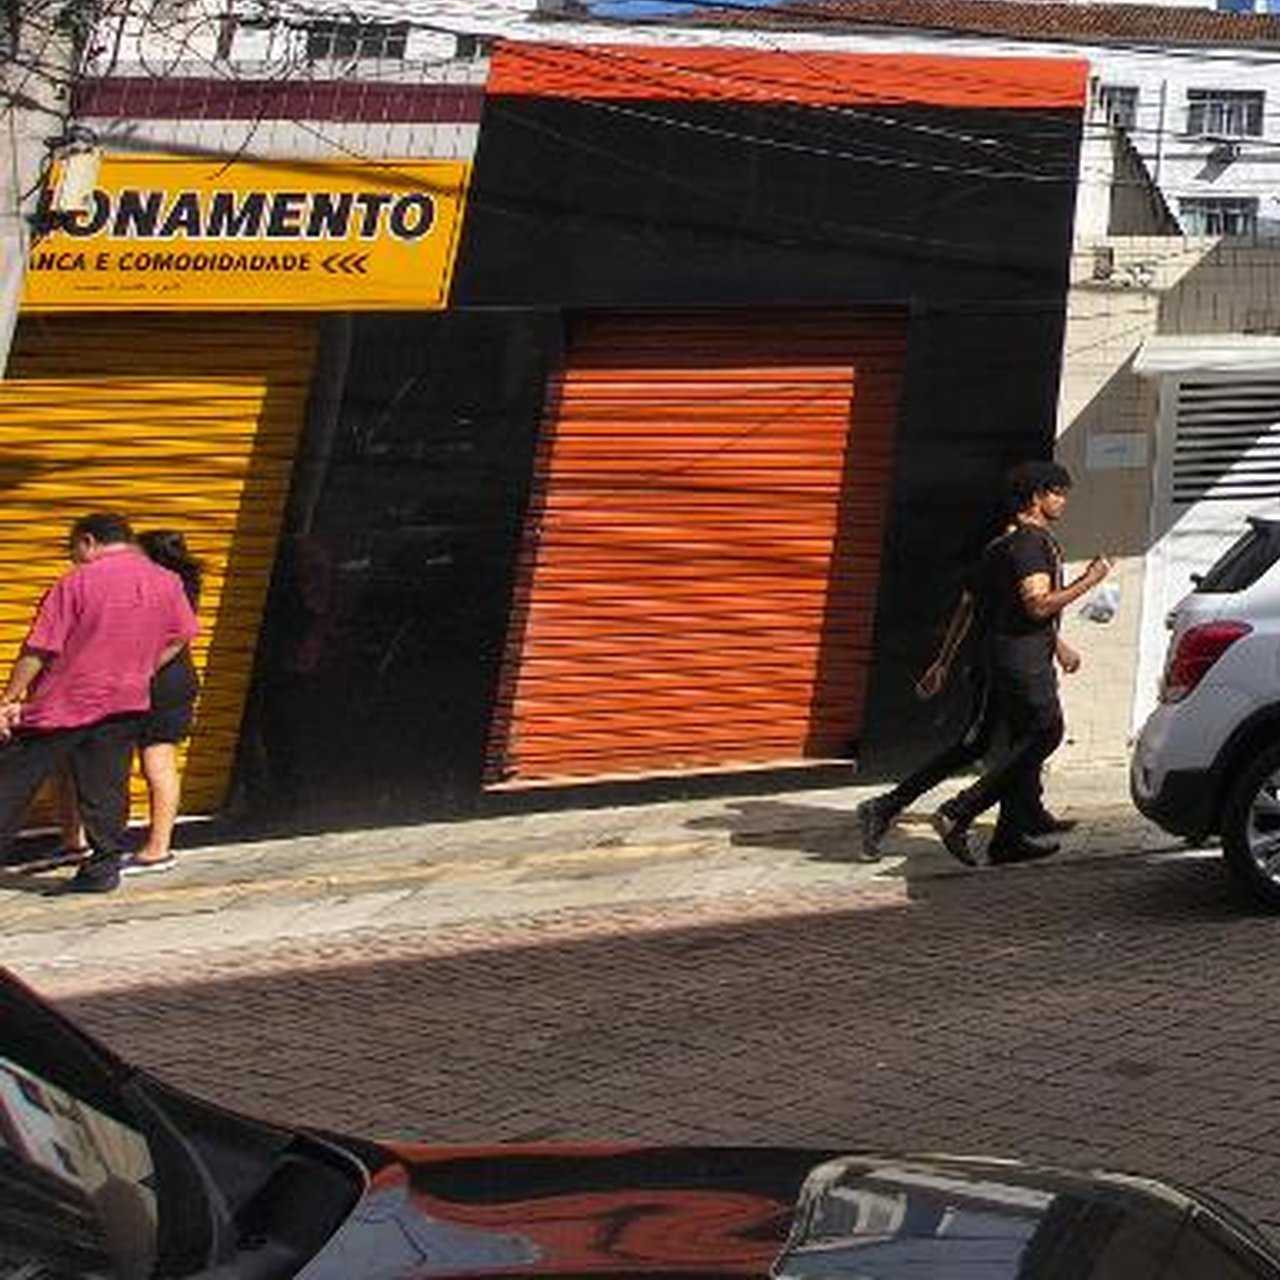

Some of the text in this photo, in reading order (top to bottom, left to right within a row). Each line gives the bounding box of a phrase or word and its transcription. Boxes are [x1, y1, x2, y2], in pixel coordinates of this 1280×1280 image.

[38, 188, 436, 239] ONAMENTO
[96, 253, 110, 271] E
[118, 252, 311, 272] COMODIDADADE
